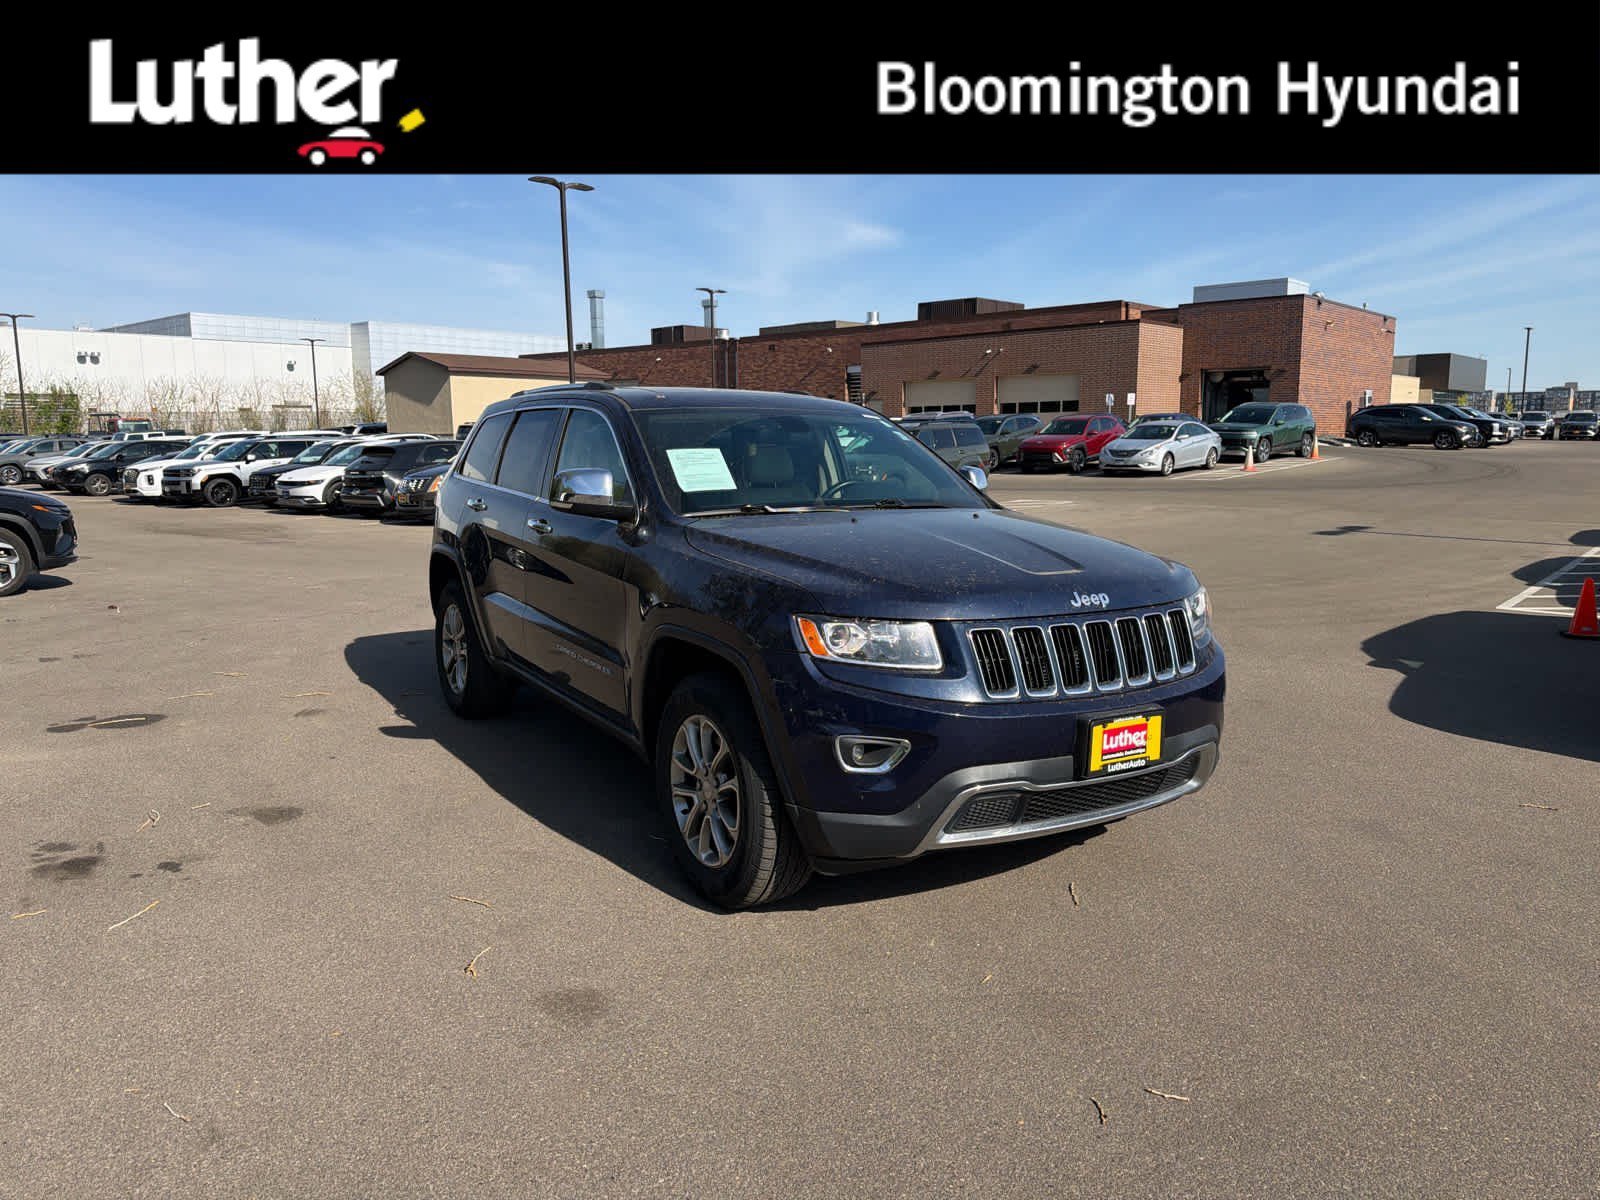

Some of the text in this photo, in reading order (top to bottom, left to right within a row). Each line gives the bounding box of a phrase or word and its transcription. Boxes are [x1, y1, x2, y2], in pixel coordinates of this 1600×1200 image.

[1070, 591, 1110, 608] Jeep
[1102, 729, 1147, 750] Luther
[1107, 759, 1146, 773] LutherAuto
